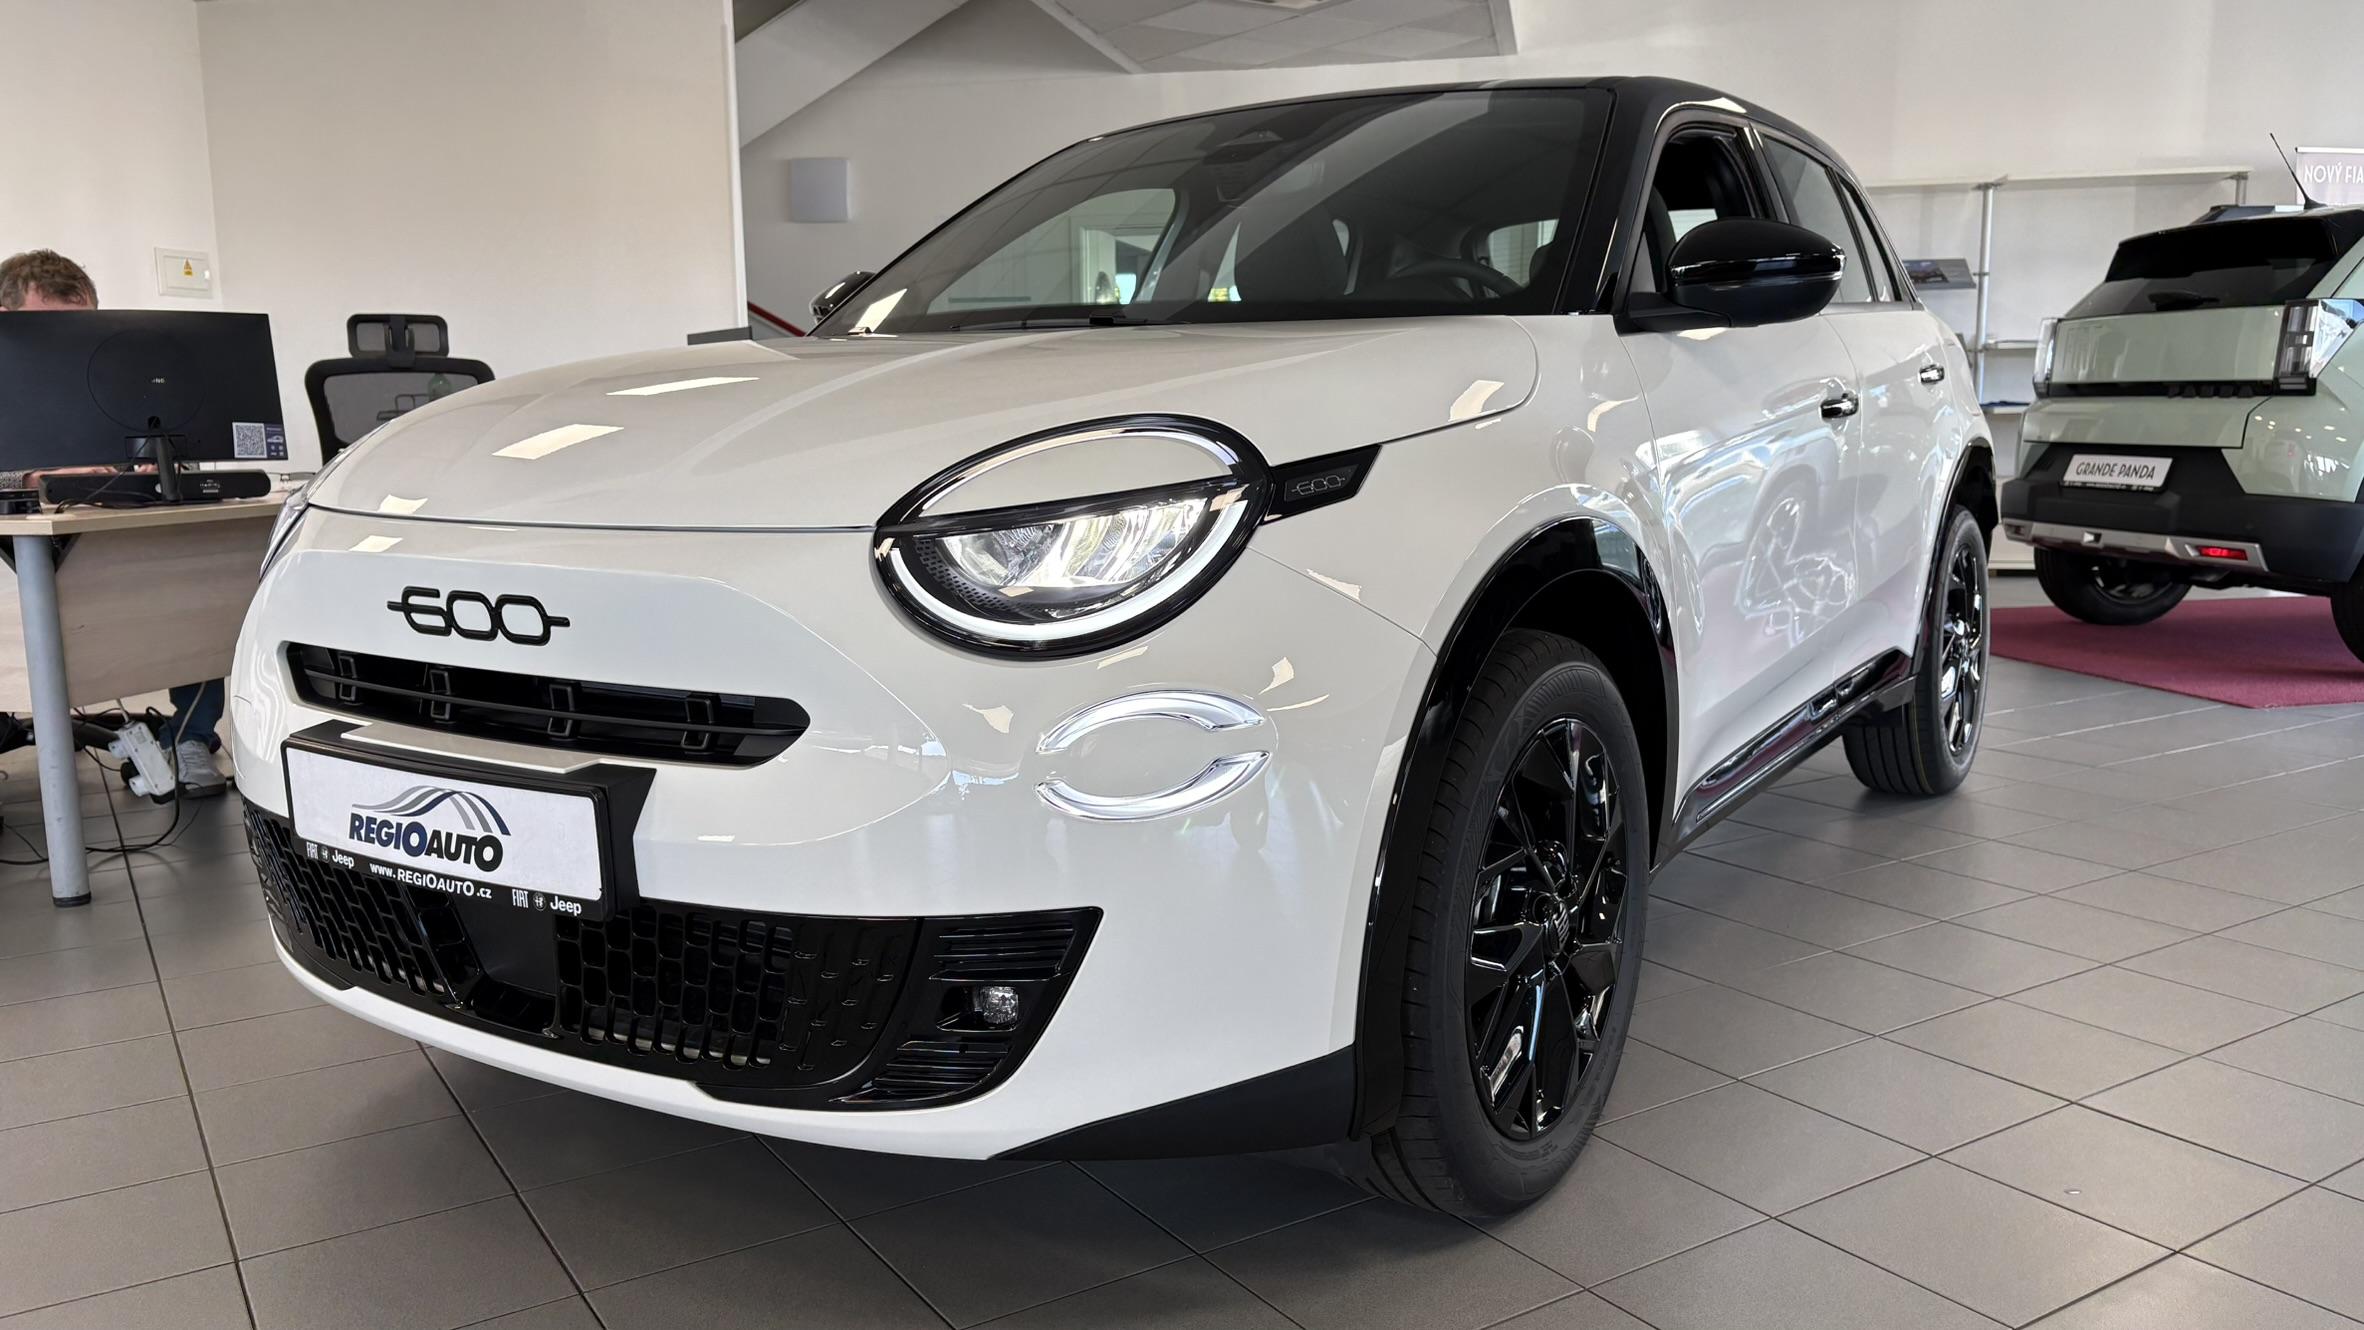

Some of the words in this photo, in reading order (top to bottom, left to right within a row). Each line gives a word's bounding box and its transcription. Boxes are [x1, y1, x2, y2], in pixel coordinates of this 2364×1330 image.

[2304, 161, 2342, 183] NOVÝ
[2075, 461, 2116, 477] GRANDE
[2117, 463, 2156, 480] PANDA
[398, 585, 555, 647] 600
[348, 812, 504, 873] REGIOAUTO
[306, 841, 319, 860] FIAT
[331, 849, 355, 869] Jeep
[511, 888, 529, 909] FIAT
[549, 896, 582, 916] Jeep
